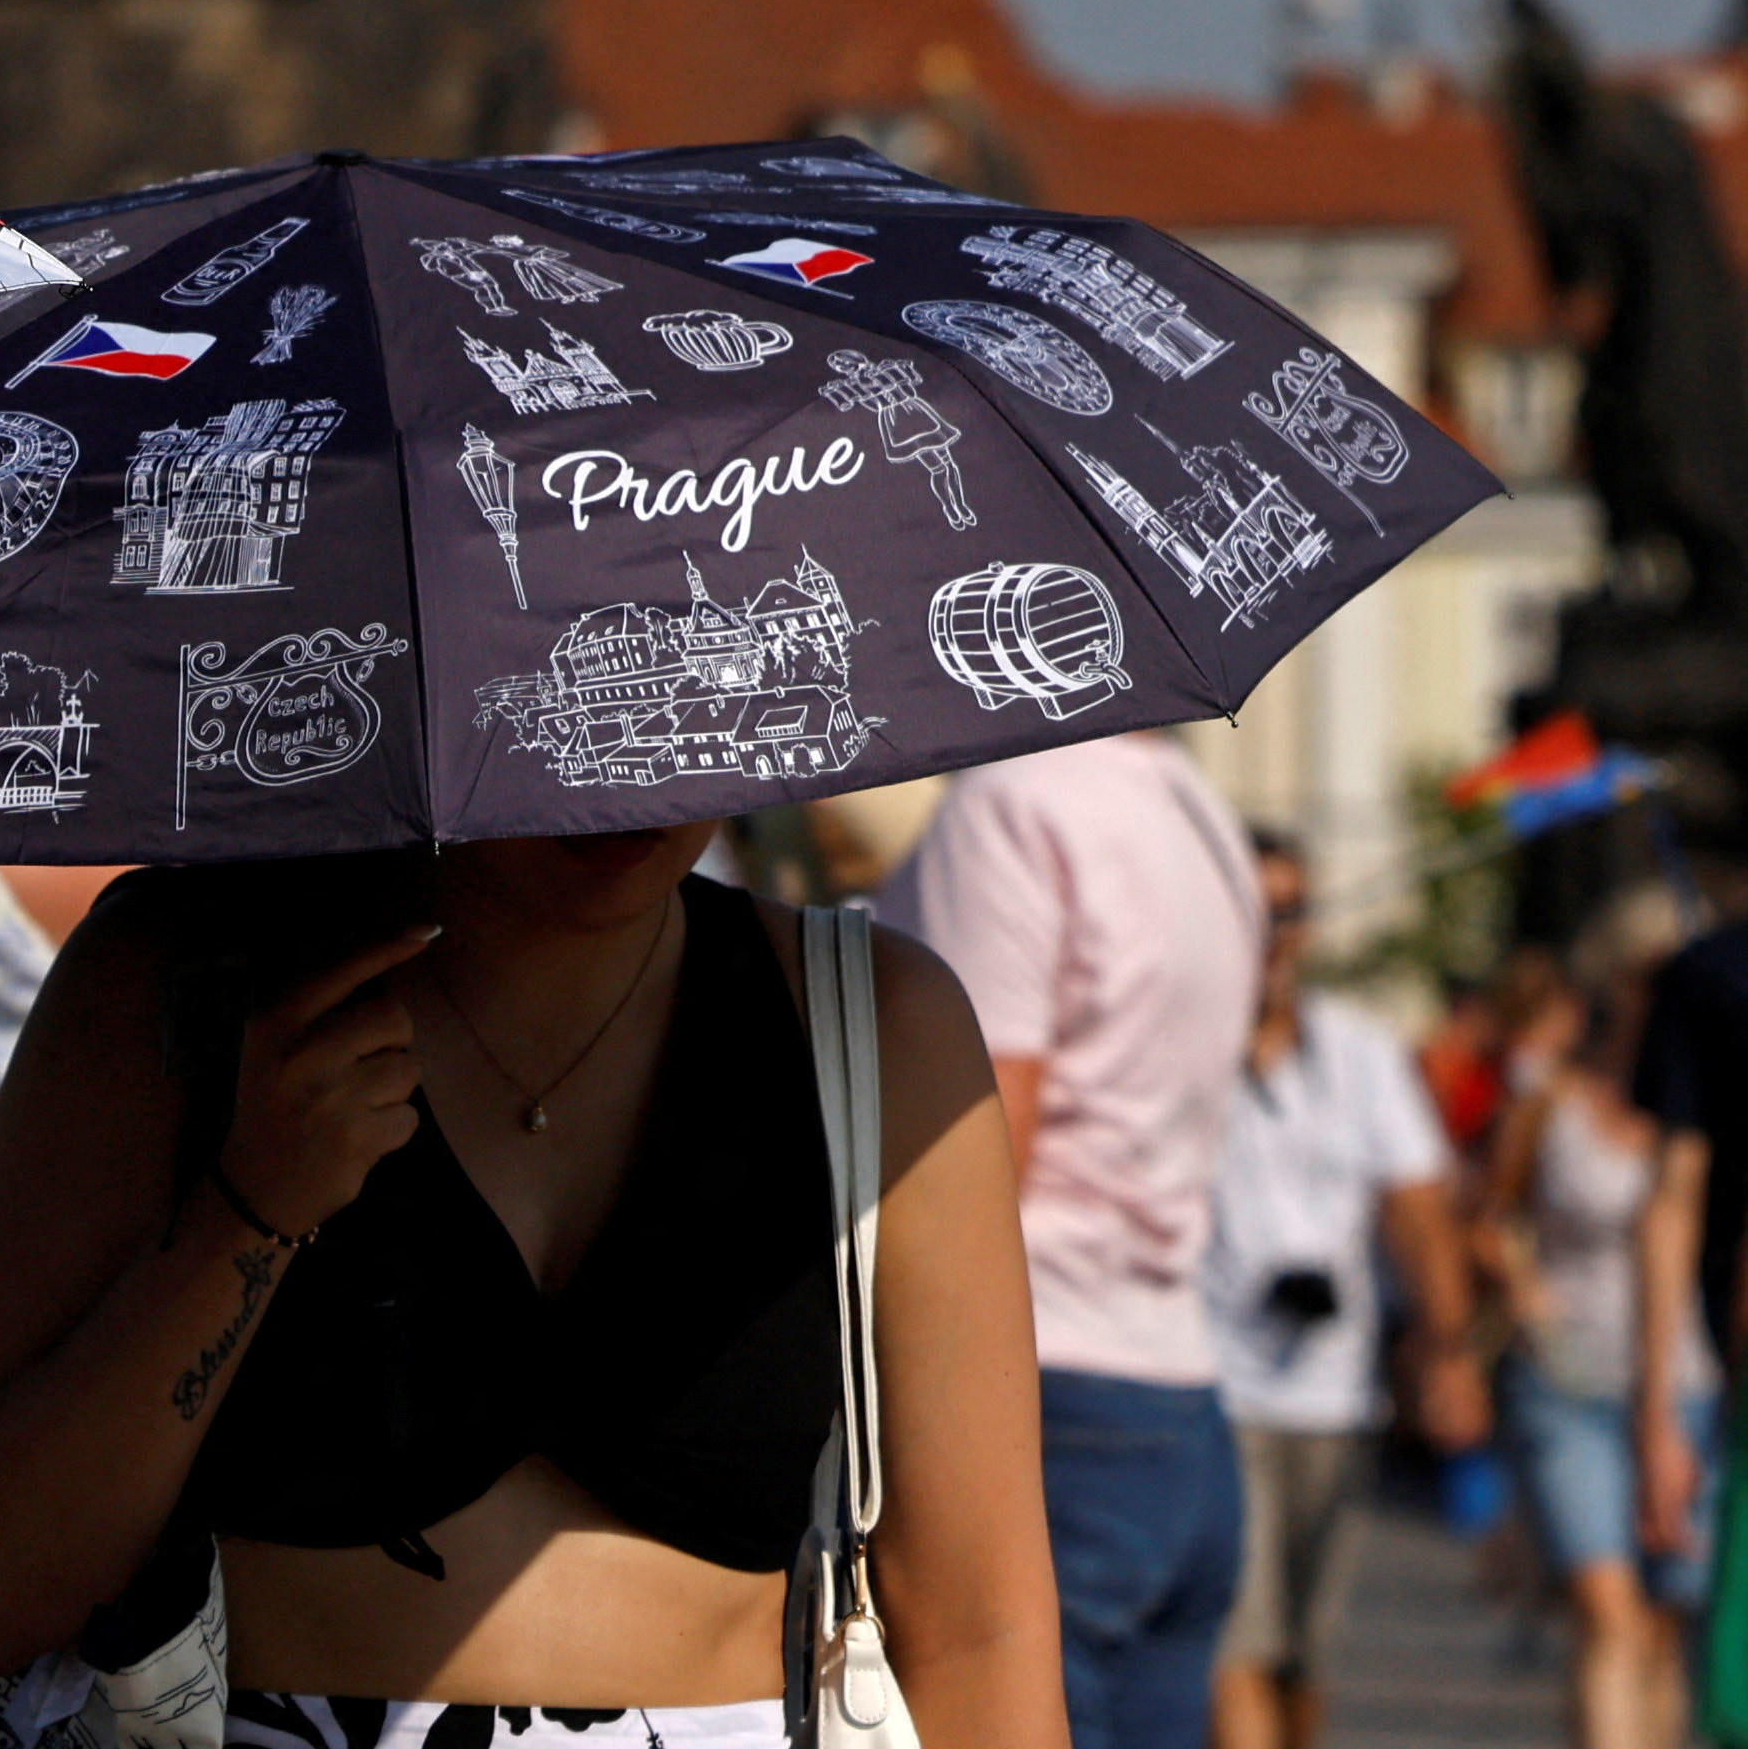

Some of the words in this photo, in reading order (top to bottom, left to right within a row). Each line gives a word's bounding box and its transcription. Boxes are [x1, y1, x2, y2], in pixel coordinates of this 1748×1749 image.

[542, 436, 865, 553] Prague
[267, 685, 335, 717] Czech
[255, 713, 347, 755] Republic
